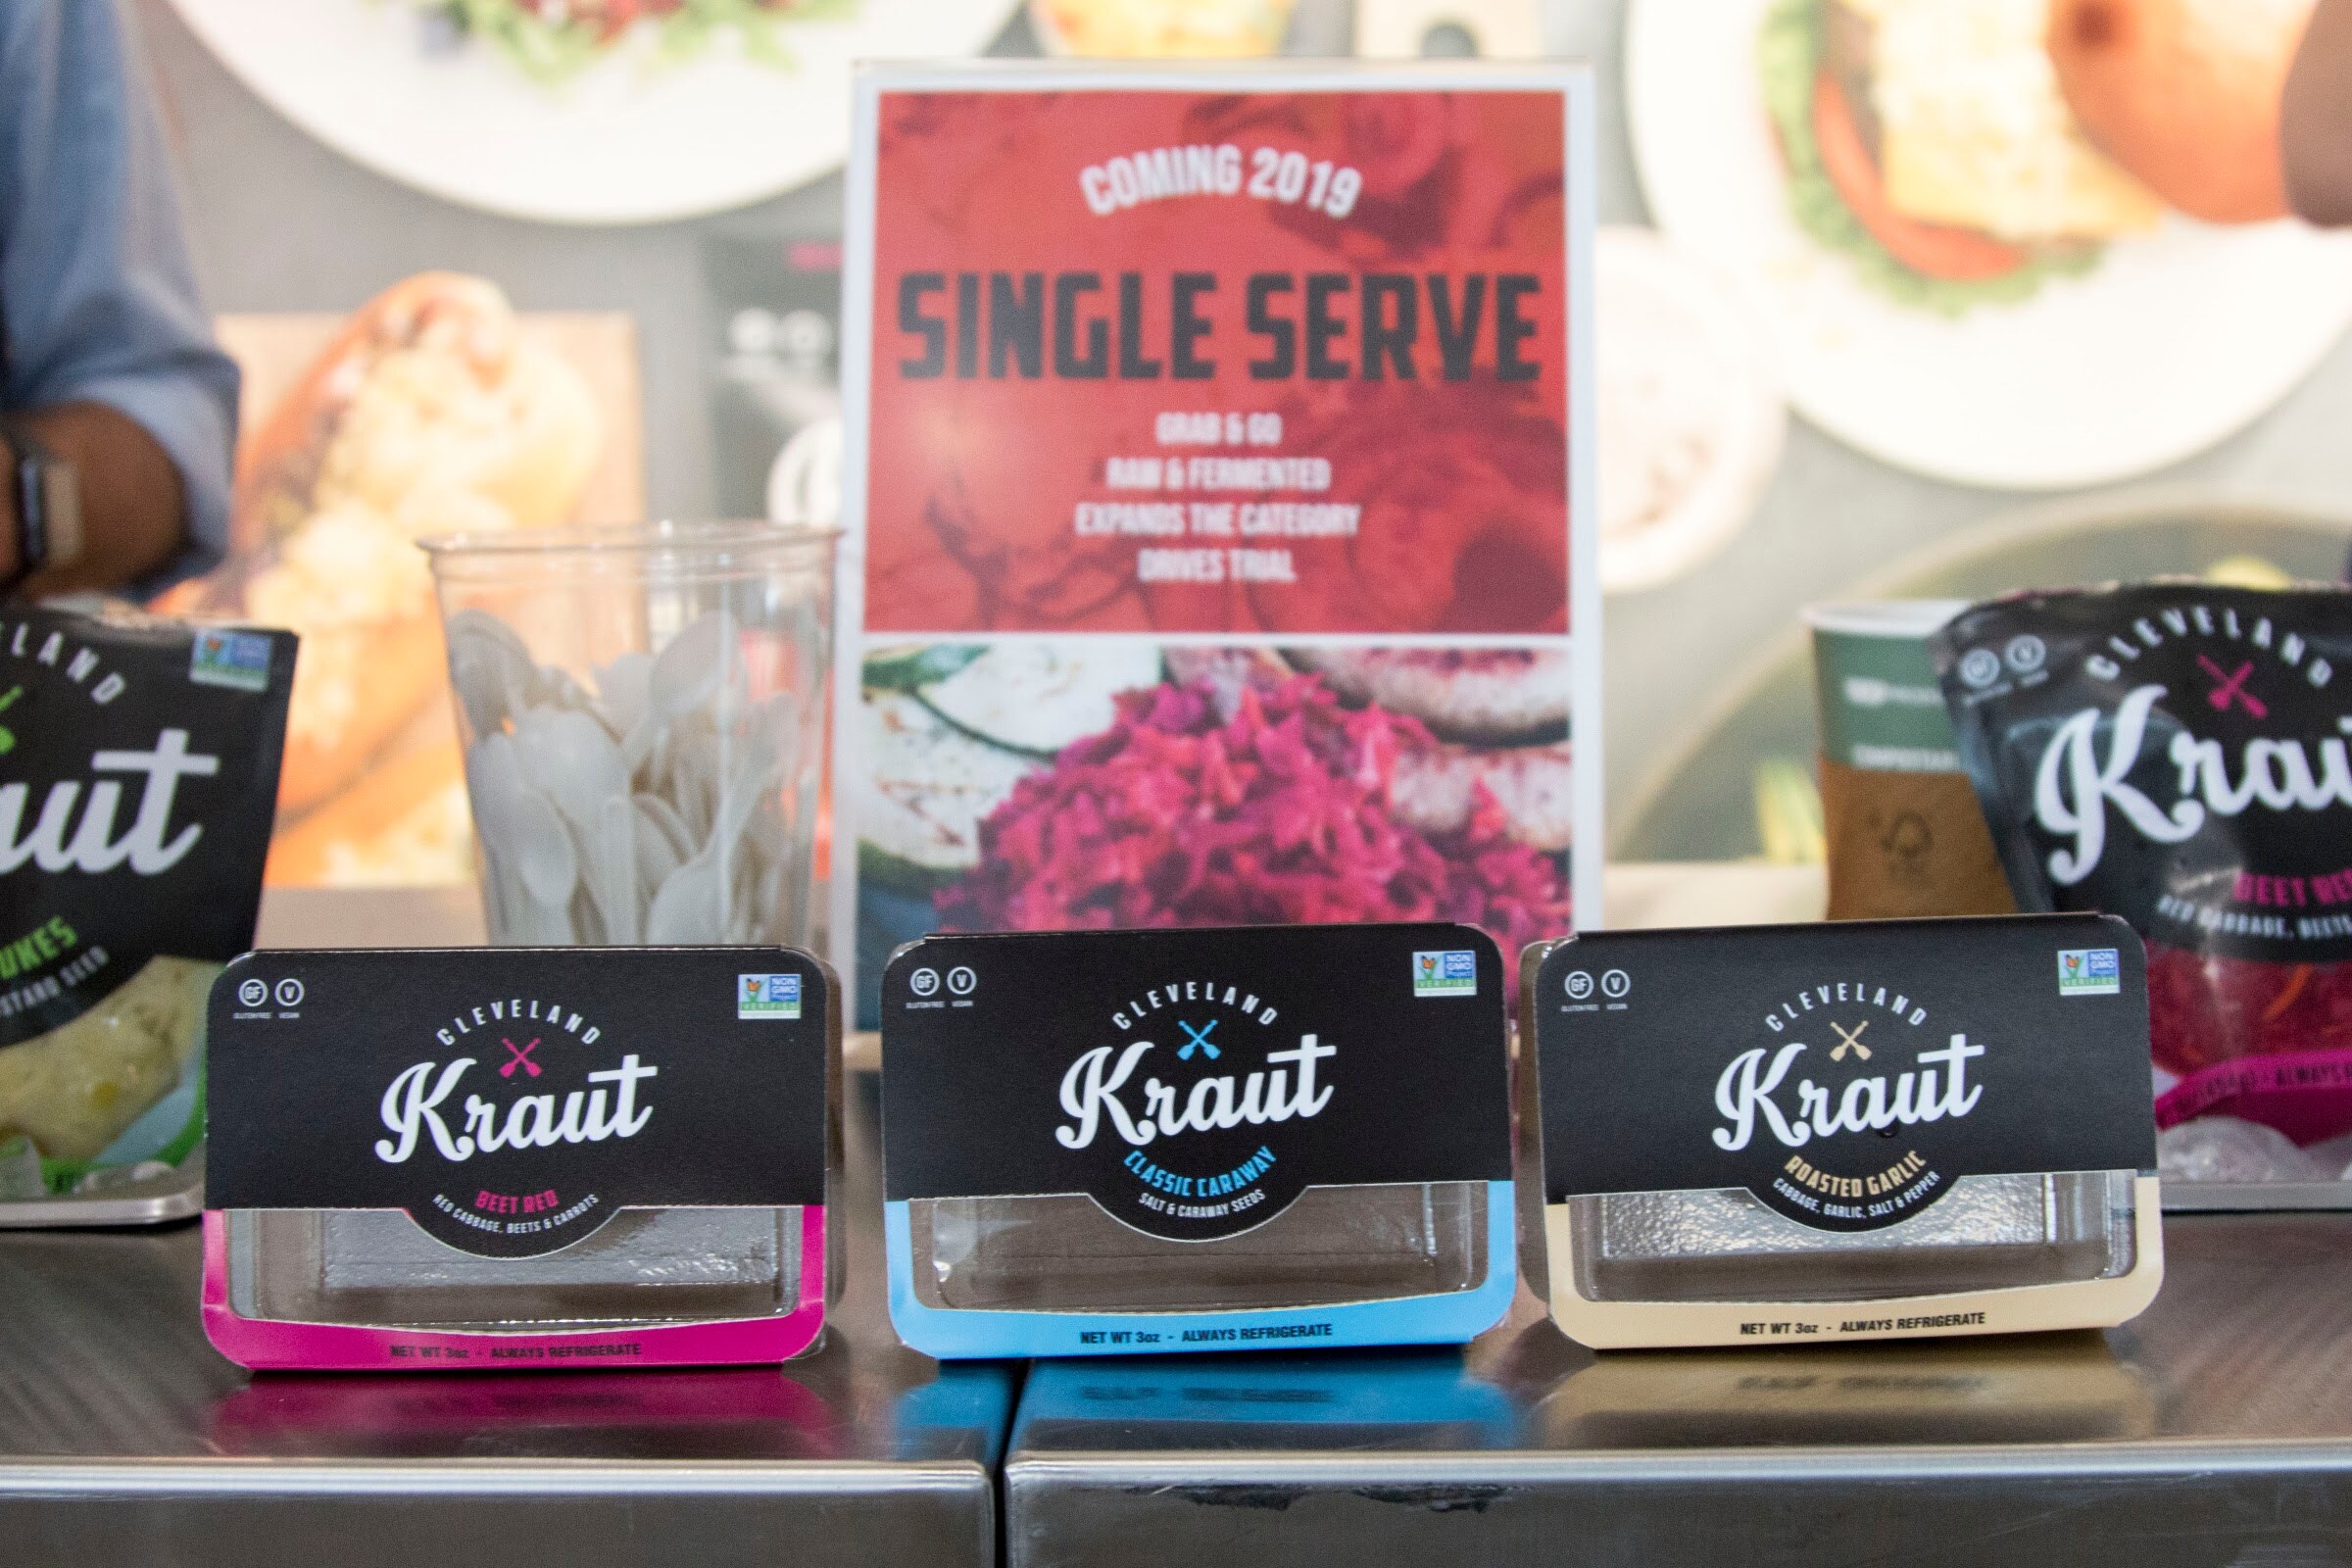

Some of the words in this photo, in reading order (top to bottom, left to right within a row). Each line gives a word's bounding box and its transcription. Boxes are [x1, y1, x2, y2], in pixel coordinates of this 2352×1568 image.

[1080, 143, 1242, 215] COMING
[1249, 146, 1362, 220] 2019
[898, 270, 1218, 380] SINGLE
[1246, 270, 1544, 381] SERVE
[1155, 412, 1221, 446] GRAB
[1247, 412, 1284, 446] GO
[1106, 457, 1162, 489] RAW
[1188, 457, 1331, 491] FERMENTED
[1075, 502, 1185, 536] EXPANDS
[1188, 503, 1235, 536] THE
[1238, 503, 1361, 536] CATEGORY
[1137, 548, 1224, 582] DRIVES
[1229, 549, 1297, 583] TRIAL
[0, 621, 125, 704] LAND
[2083, 605, 2333, 688] CLEVELAND
[2232, 871, 2307, 906] BEET
[956, 974, 967, 988] V
[1446, 961, 1472, 971] GMO
[2090, 960, 2115, 969] GMO
[245, 986, 262, 1000] GF
[284, 986, 295, 1000] V
[772, 985, 798, 994] GMO
[916, 975, 932, 989] GF
[1571, 978, 1587, 992] GF
[1610, 977, 1621, 991] V
[436, 999, 601, 1046] CLEVELAND
[1112, 981, 1278, 1030] CLEVELAND
[1765, 982, 1927, 1031] CLEVELAND
[374, 1054, 658, 1163] Kraut
[1054, 1034, 1337, 1150] Kraut
[1712, 1033, 1985, 1152] Kraut
[1123, 1150, 1193, 1197] CLASSIC
[1197, 1145, 1277, 1197] CARAWAY
[1784, 1154, 1862, 1198] ROASTED
[1866, 1150, 1927, 1196] GARLIC
[474, 1189, 518, 1214] BEET
[522, 1189, 559, 1214] RED
[1138, 1192, 1166, 1211] SALT
[1166, 1202, 1176, 1215] &
[1177, 1203, 1230, 1218] CARAWAY
[1231, 1189, 1266, 1212] SEEDS
[1868, 1199, 1894, 1216] SALT
[1894, 1196, 1905, 1208] &
[1902, 1170, 1940, 1203] PEPPER
[506, 1221, 541, 1234] BEETS
[553, 1194, 600, 1226] CARROTS
[1080, 1331, 1107, 1344] NET
[1110, 1331, 1132, 1344] WT
[1136, 1331, 1160, 1344] 3oz
[1182, 1329, 1237, 1342] ALWAYS
[1241, 1323, 1332, 1340] REFRIGERATE
[1740, 1323, 1765, 1335] NET
[1770, 1323, 1790, 1334] WT
[1795, 1323, 1818, 1334] 3oz
[1839, 1319, 1892, 1332] ALWAYS
[1897, 1312, 1985, 1330] REFRIGERATE
[391, 1346, 415, 1357] NET
[419, 1346, 440, 1358] WT
[445, 1348, 468, 1358] 3oz
[491, 1347, 544, 1358] ALWAYS
[548, 1344, 641, 1358] REFRIGERATE
